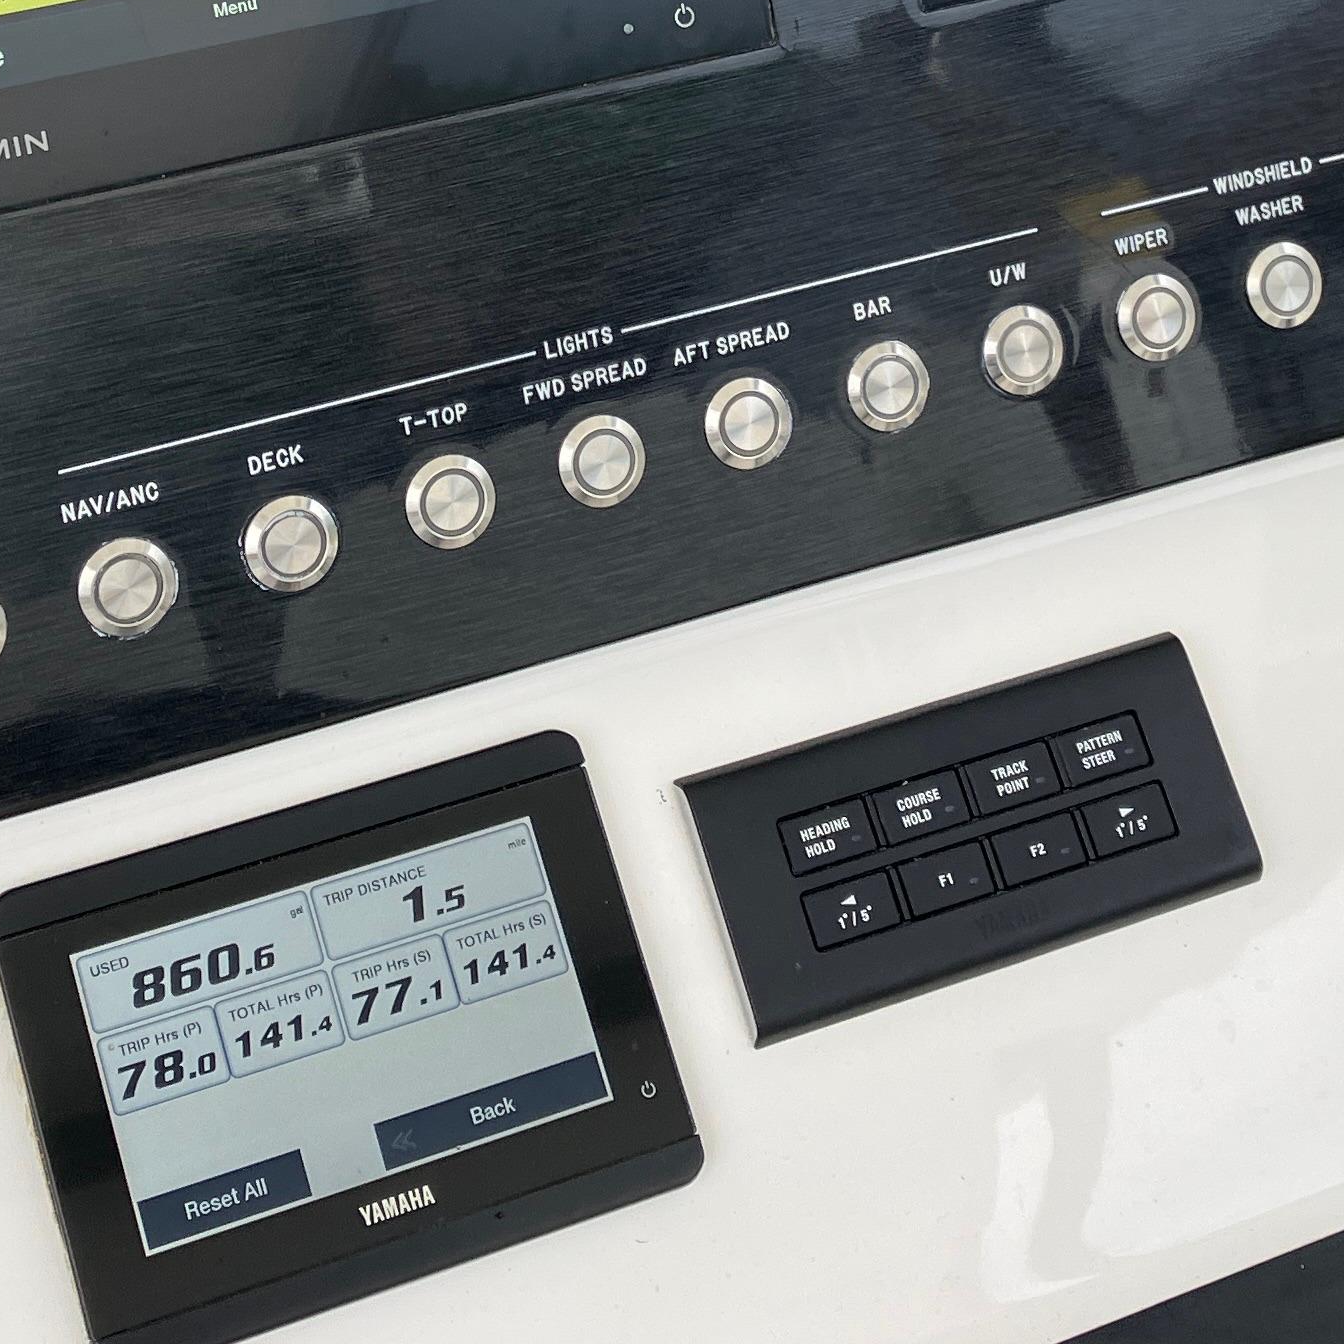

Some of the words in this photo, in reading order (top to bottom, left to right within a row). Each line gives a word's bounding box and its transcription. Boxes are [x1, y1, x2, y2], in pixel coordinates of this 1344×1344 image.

[1213, 157, 1313, 196] WINDSHIELD
[1235, 194, 1305, 226] WASHER
[1114, 227, 1169, 257] WIPER
[989, 261, 1028, 288] U/W
[852, 294, 893, 322] BAR
[543, 325, 614, 360] LIGHTS
[673, 340, 710, 367] AFT
[715, 321, 791, 356] SPREAD
[522, 376, 565, 406] FWD
[571, 357, 647, 393] SPREAD
[398, 402, 468, 437] T-TOP
[247, 443, 305, 475] DECK
[59, 481, 160, 524] NAV/ANC
[1076, 729, 1123, 755] PATTERN
[1082, 749, 1116, 769] STEER
[990, 759, 1029, 782] TRACK
[996, 777, 1030, 797] POINT
[896, 788, 941, 813] COURSE
[799, 815, 851, 843] HEADING
[902, 808, 932, 829] HOLD
[804, 838, 836, 859] HOLD
[1029, 842, 1047, 858] F2
[322, 885, 354, 908] TRIP
[356, 864, 427, 899] DISTANCE
[938, 872, 954, 889] F1
[402, 884, 467, 923] 1.5
[455, 926, 500, 951] TOTAL
[501, 918, 525, 939] Hrs
[526, 911, 547, 932] (S)
[89, 955, 130, 979] USED
[132, 941, 277, 1011] 860.6
[351, 962, 385, 984] TRIP
[387, 955, 411, 974] Hrs
[411, 947, 432, 968] (S)
[461, 941, 557, 986] 141.4
[228, 998, 275, 1023] TOTAL
[277, 989, 301, 1009] Hrs
[303, 981, 324, 1003] (P)
[351, 976, 445, 1027] 77.1
[117, 1034, 151, 1056] TRIP
[154, 1026, 179, 1047] Hrs
[181, 1019, 203, 1040] (P)
[234, 1012, 333, 1060] 141.4
[117, 1048, 217, 1102] 78.0
[469, 1096, 517, 1126] Back
[184, 1184, 241, 1222] Reset
[244, 1176, 269, 1202] All
[358, 1184, 437, 1229] YAMAHA
